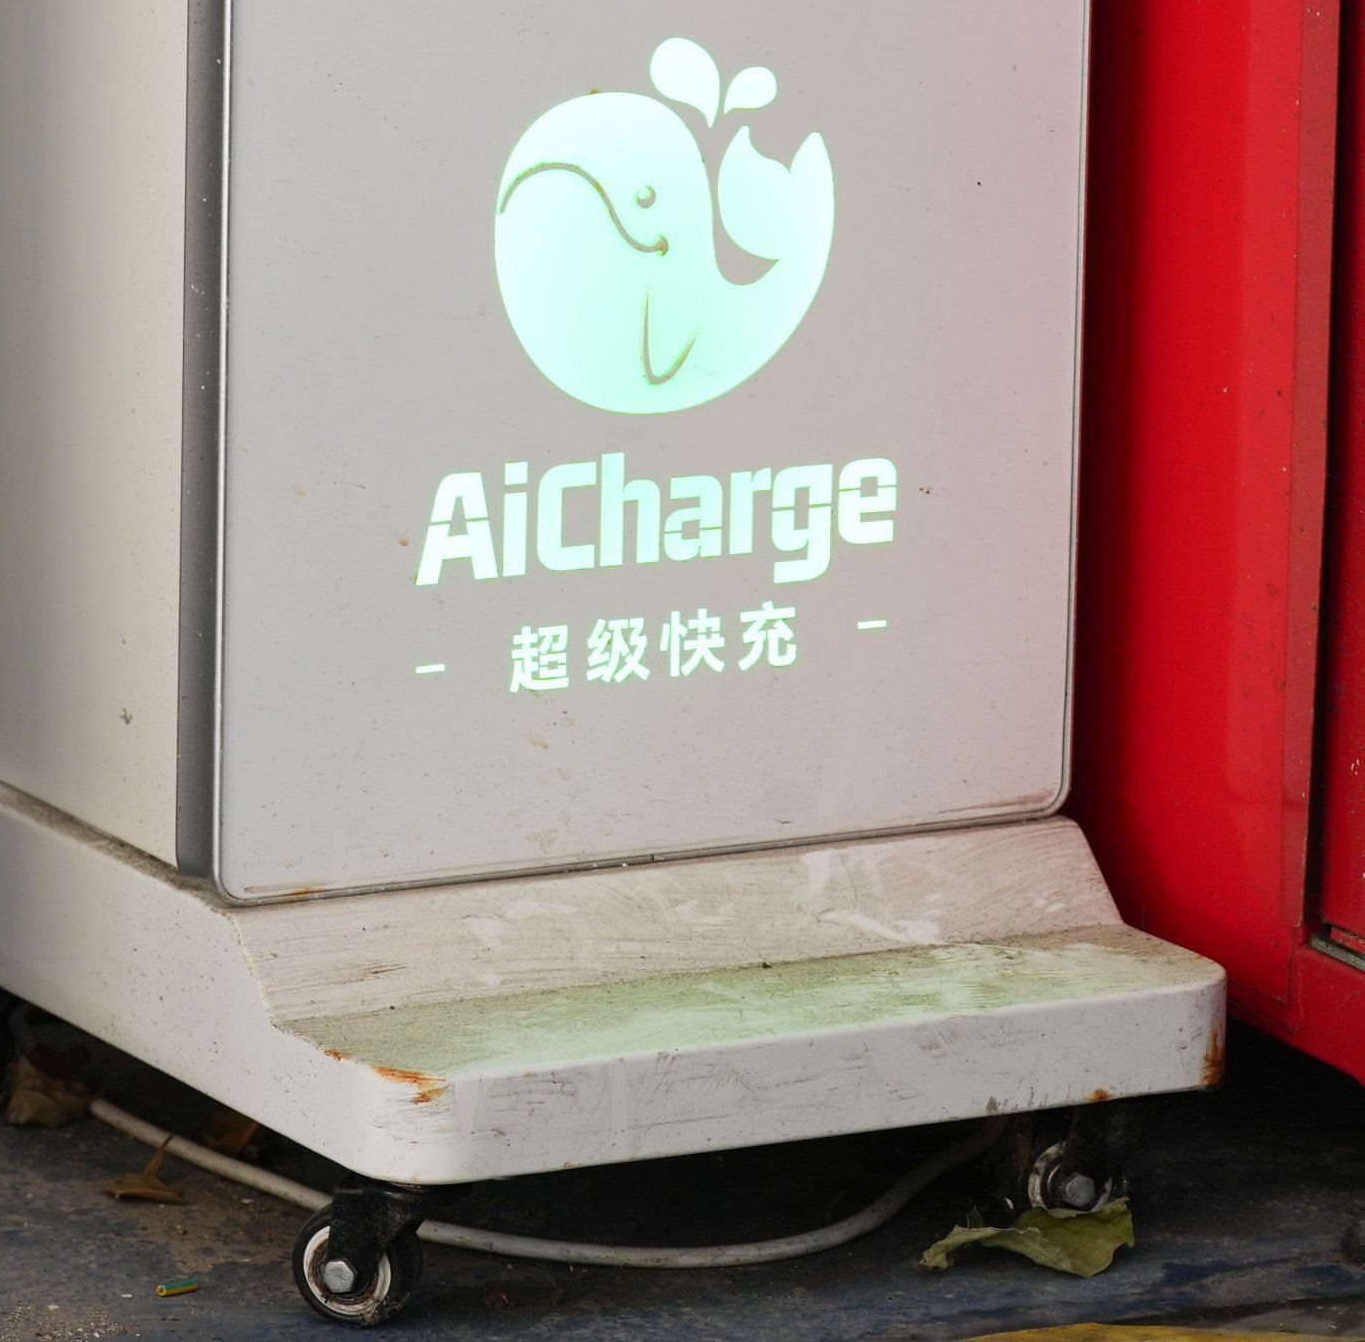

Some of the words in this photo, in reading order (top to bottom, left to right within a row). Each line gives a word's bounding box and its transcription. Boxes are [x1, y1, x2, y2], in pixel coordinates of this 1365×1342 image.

[415, 451, 898, 587] AiCharge
[509, 600, 798, 694] 超级快充
